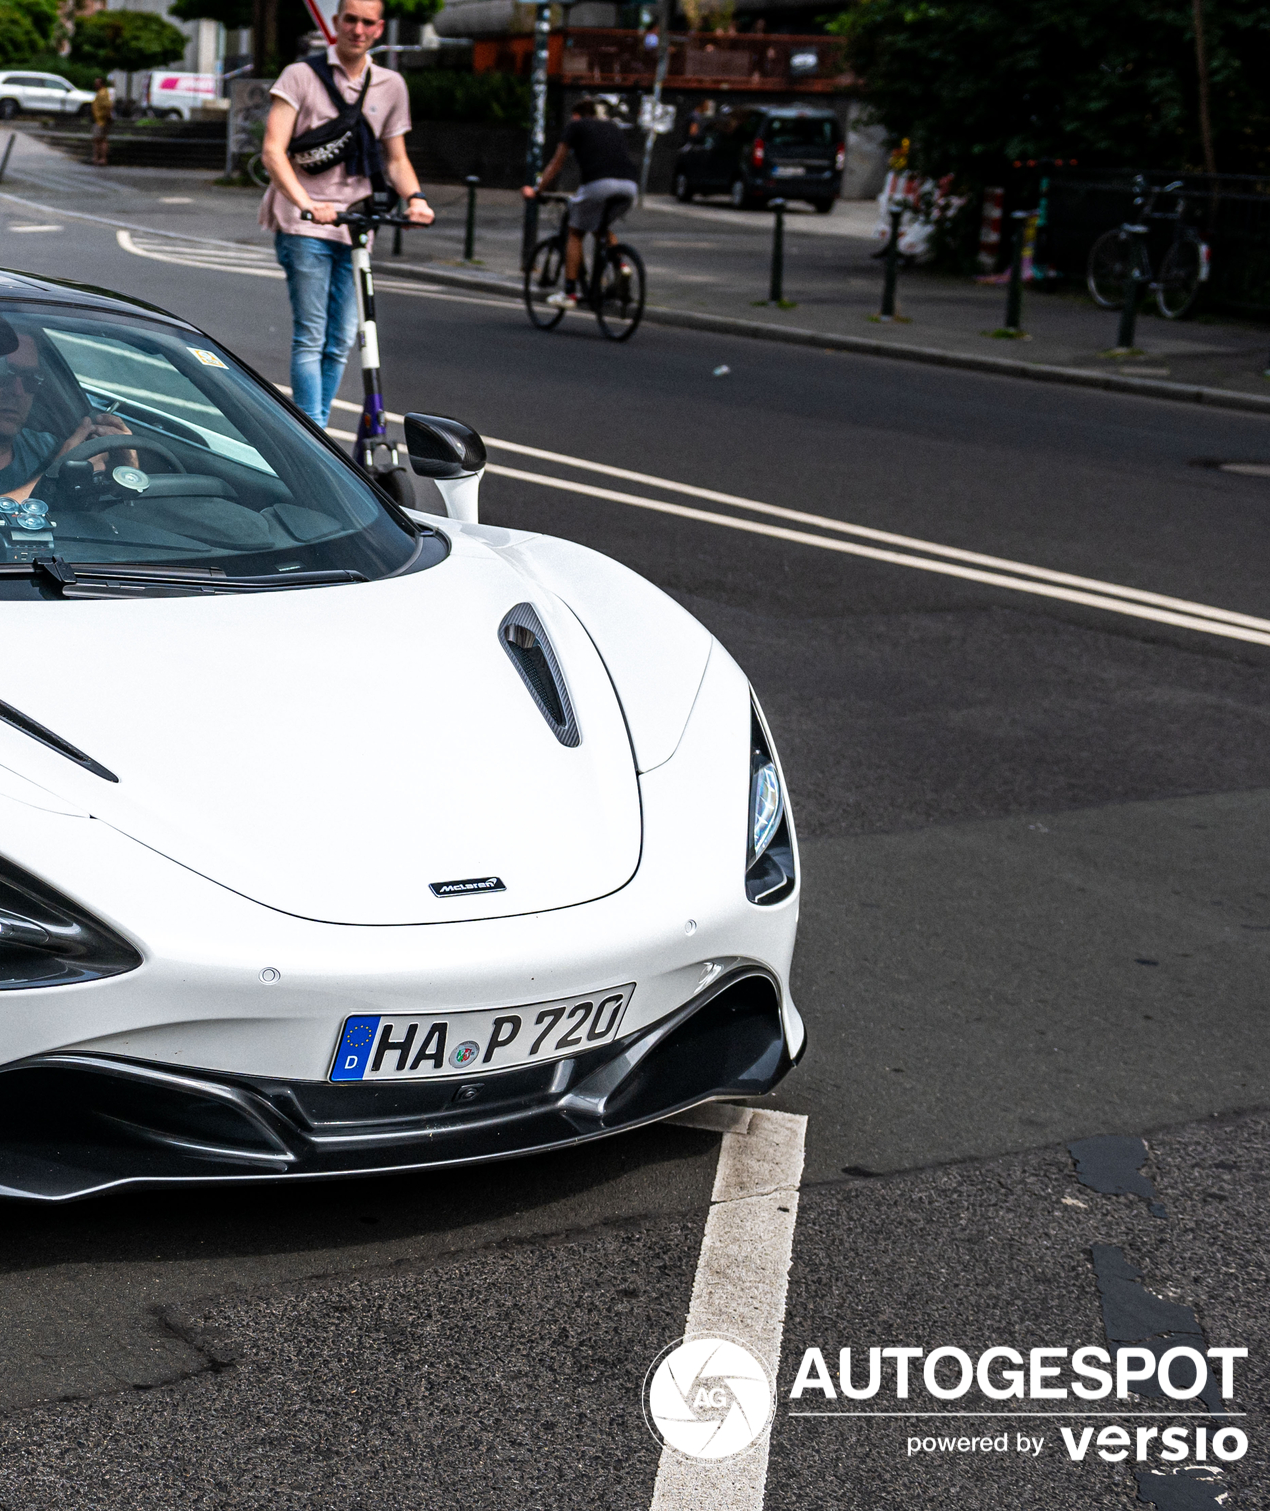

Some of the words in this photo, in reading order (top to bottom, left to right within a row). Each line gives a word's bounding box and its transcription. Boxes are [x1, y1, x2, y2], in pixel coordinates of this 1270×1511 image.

[439, 880, 496, 893] McLaren
[344, 1055, 359, 1070] D
[370, 1022, 449, 1072] HA
[482, 1015, 522, 1063] P
[529, 994, 624, 1056] 720
